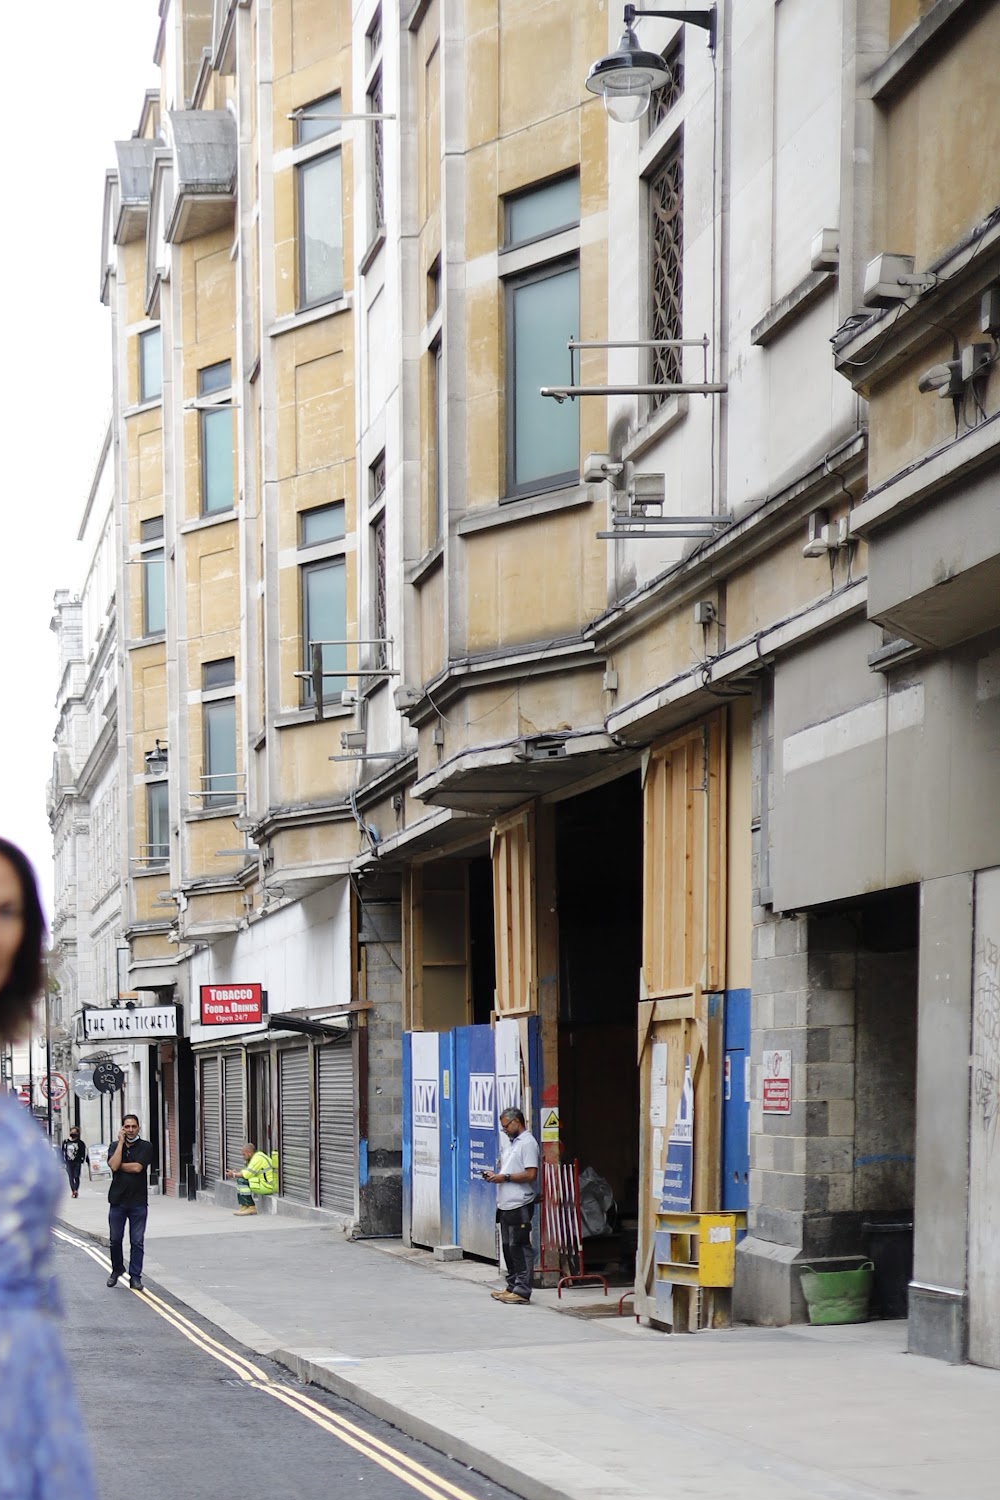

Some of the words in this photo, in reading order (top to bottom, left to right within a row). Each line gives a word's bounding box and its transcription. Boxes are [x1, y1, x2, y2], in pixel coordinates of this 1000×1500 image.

[209, 988, 253, 1001] TOBACCO
[204, 1003, 224, 1014] FOOD
[224, 1005, 230, 1013] &
[231, 1002, 259, 1013] DRINKS
[88, 1018, 104, 1031] THE
[135, 1014, 175, 1030] TICKETS
[215, 1015, 234, 1023] Open
[470, 1081, 493, 1112] MY
